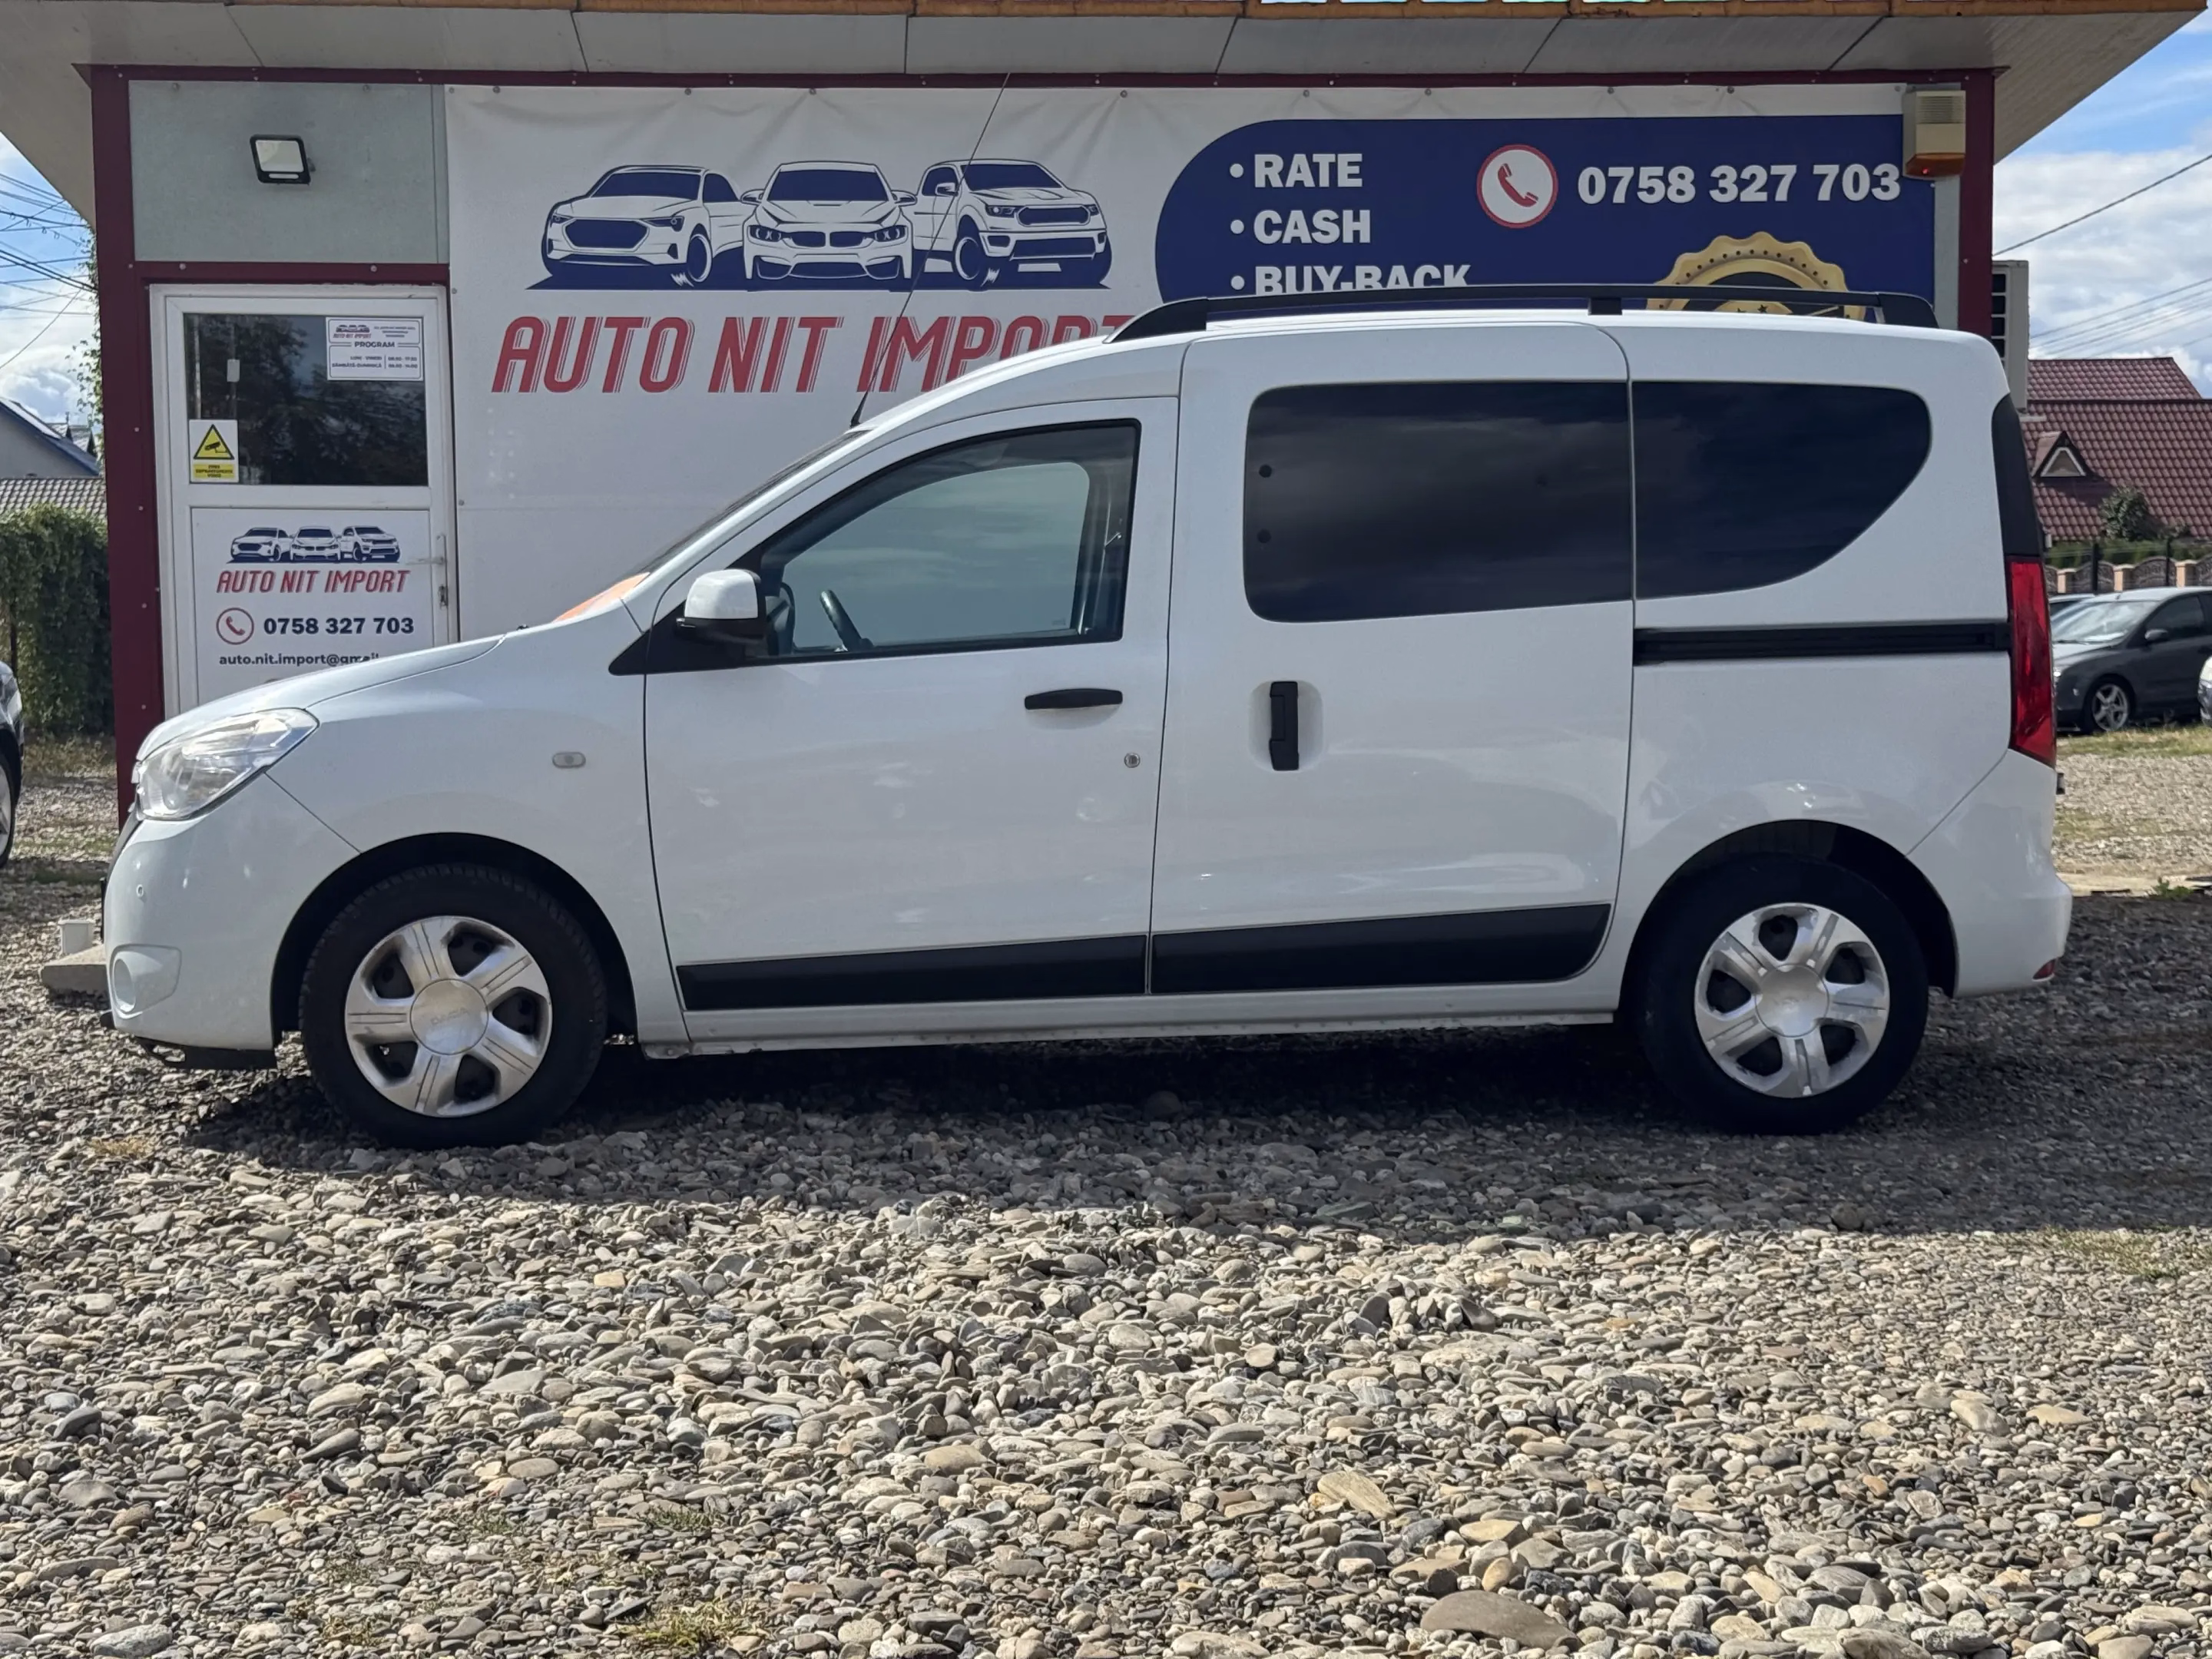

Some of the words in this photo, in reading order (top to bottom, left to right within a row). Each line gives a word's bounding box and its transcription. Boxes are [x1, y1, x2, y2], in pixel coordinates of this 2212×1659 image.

[1253, 153, 1363, 188] RATE
[1577, 165, 1697, 204] 0758
[1708, 164, 1798, 204] 327
[1812, 163, 1902, 202] 703
[1253, 209, 1372, 244] CASH
[1254, 264, 1472, 296] BUY-BACK
[491, 316, 696, 393] AUTO
[707, 316, 845, 393] NIT
[216, 570, 276, 594] AUTO
[280, 570, 321, 594] NIT
[324, 570, 412, 594] IMPORT
[263, 618, 320, 635] 0758
[325, 618, 366, 635] 327
[373, 617, 415, 634] 703
